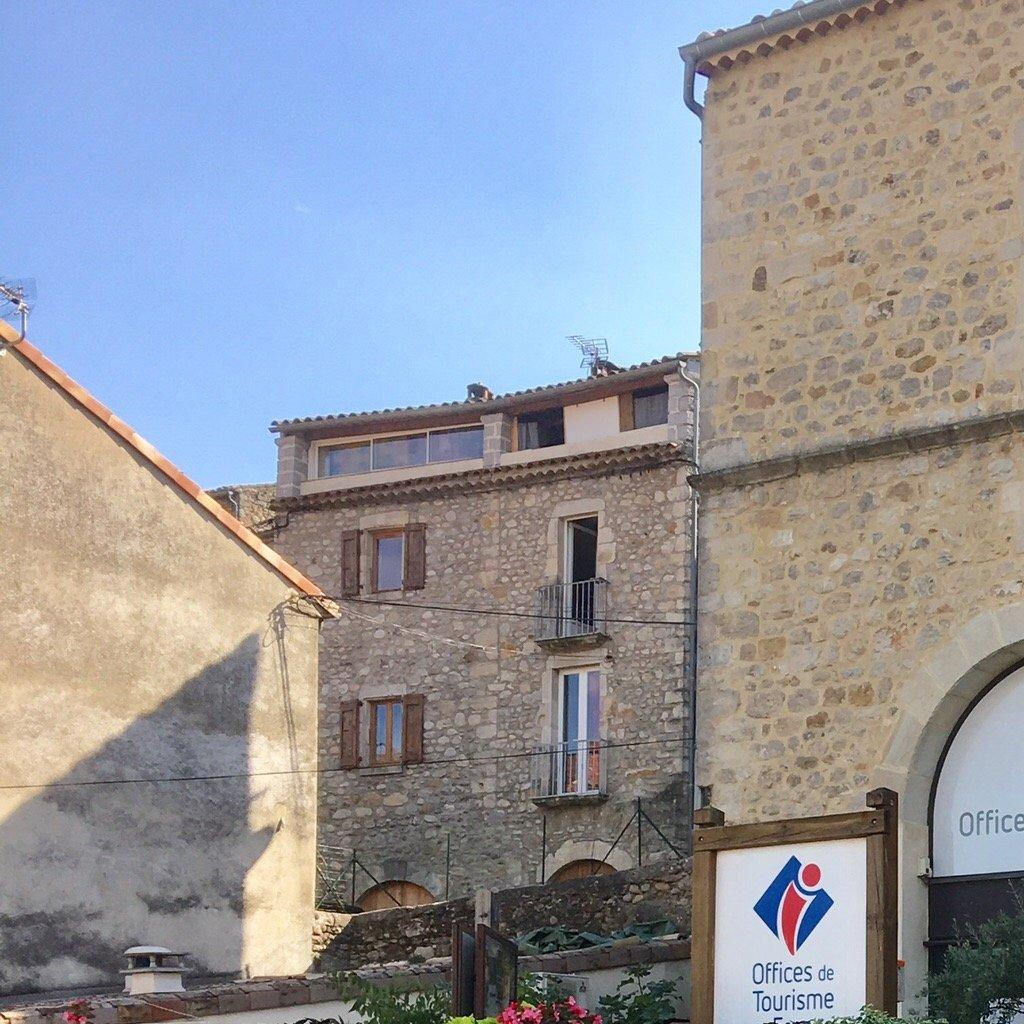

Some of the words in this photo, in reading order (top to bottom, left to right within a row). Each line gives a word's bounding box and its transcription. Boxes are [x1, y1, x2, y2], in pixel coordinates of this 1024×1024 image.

[752, 961, 813, 985] Offices
[818, 964, 835, 981] de
[752, 988, 835, 1013] Tourisme
